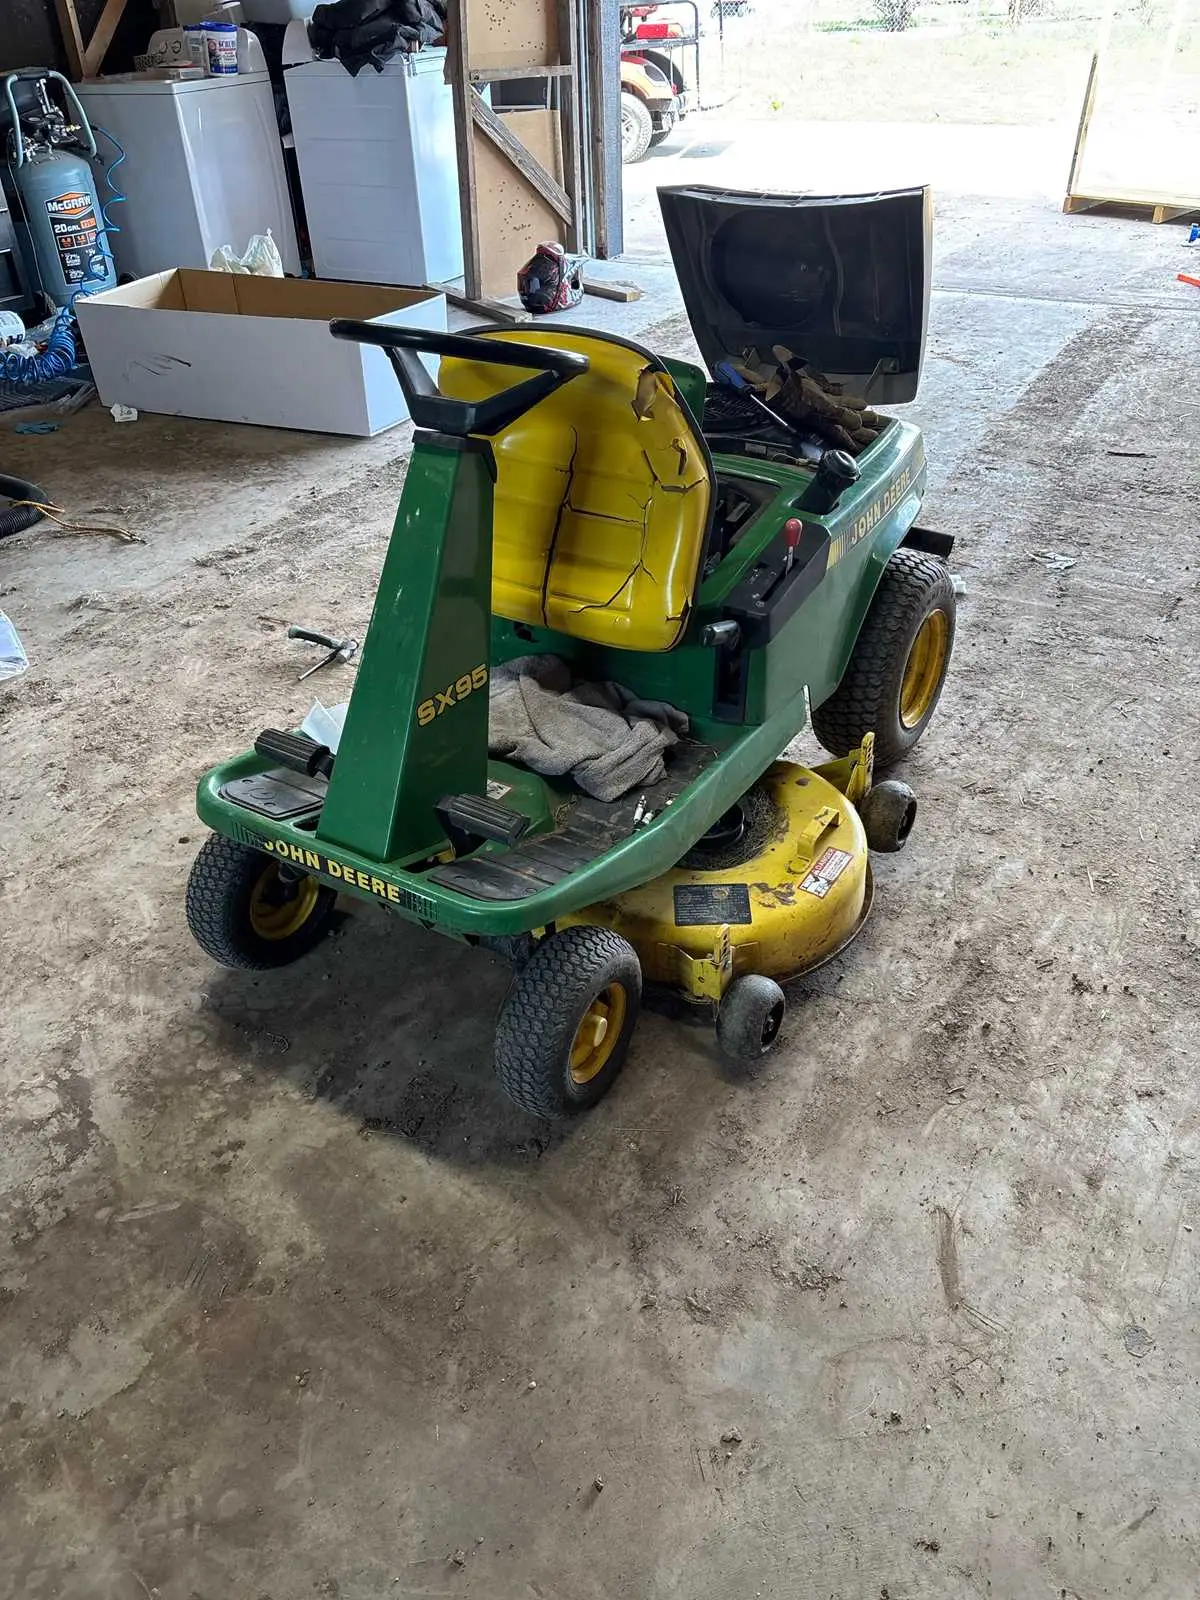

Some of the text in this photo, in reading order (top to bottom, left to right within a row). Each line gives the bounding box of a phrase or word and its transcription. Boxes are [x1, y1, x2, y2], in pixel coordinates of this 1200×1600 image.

[54, 223, 67, 233] 20
[851, 467, 911, 545] JOHN DEERE
[417, 663, 488, 726] SX95
[264, 839, 401, 903] JOHN DEERE
